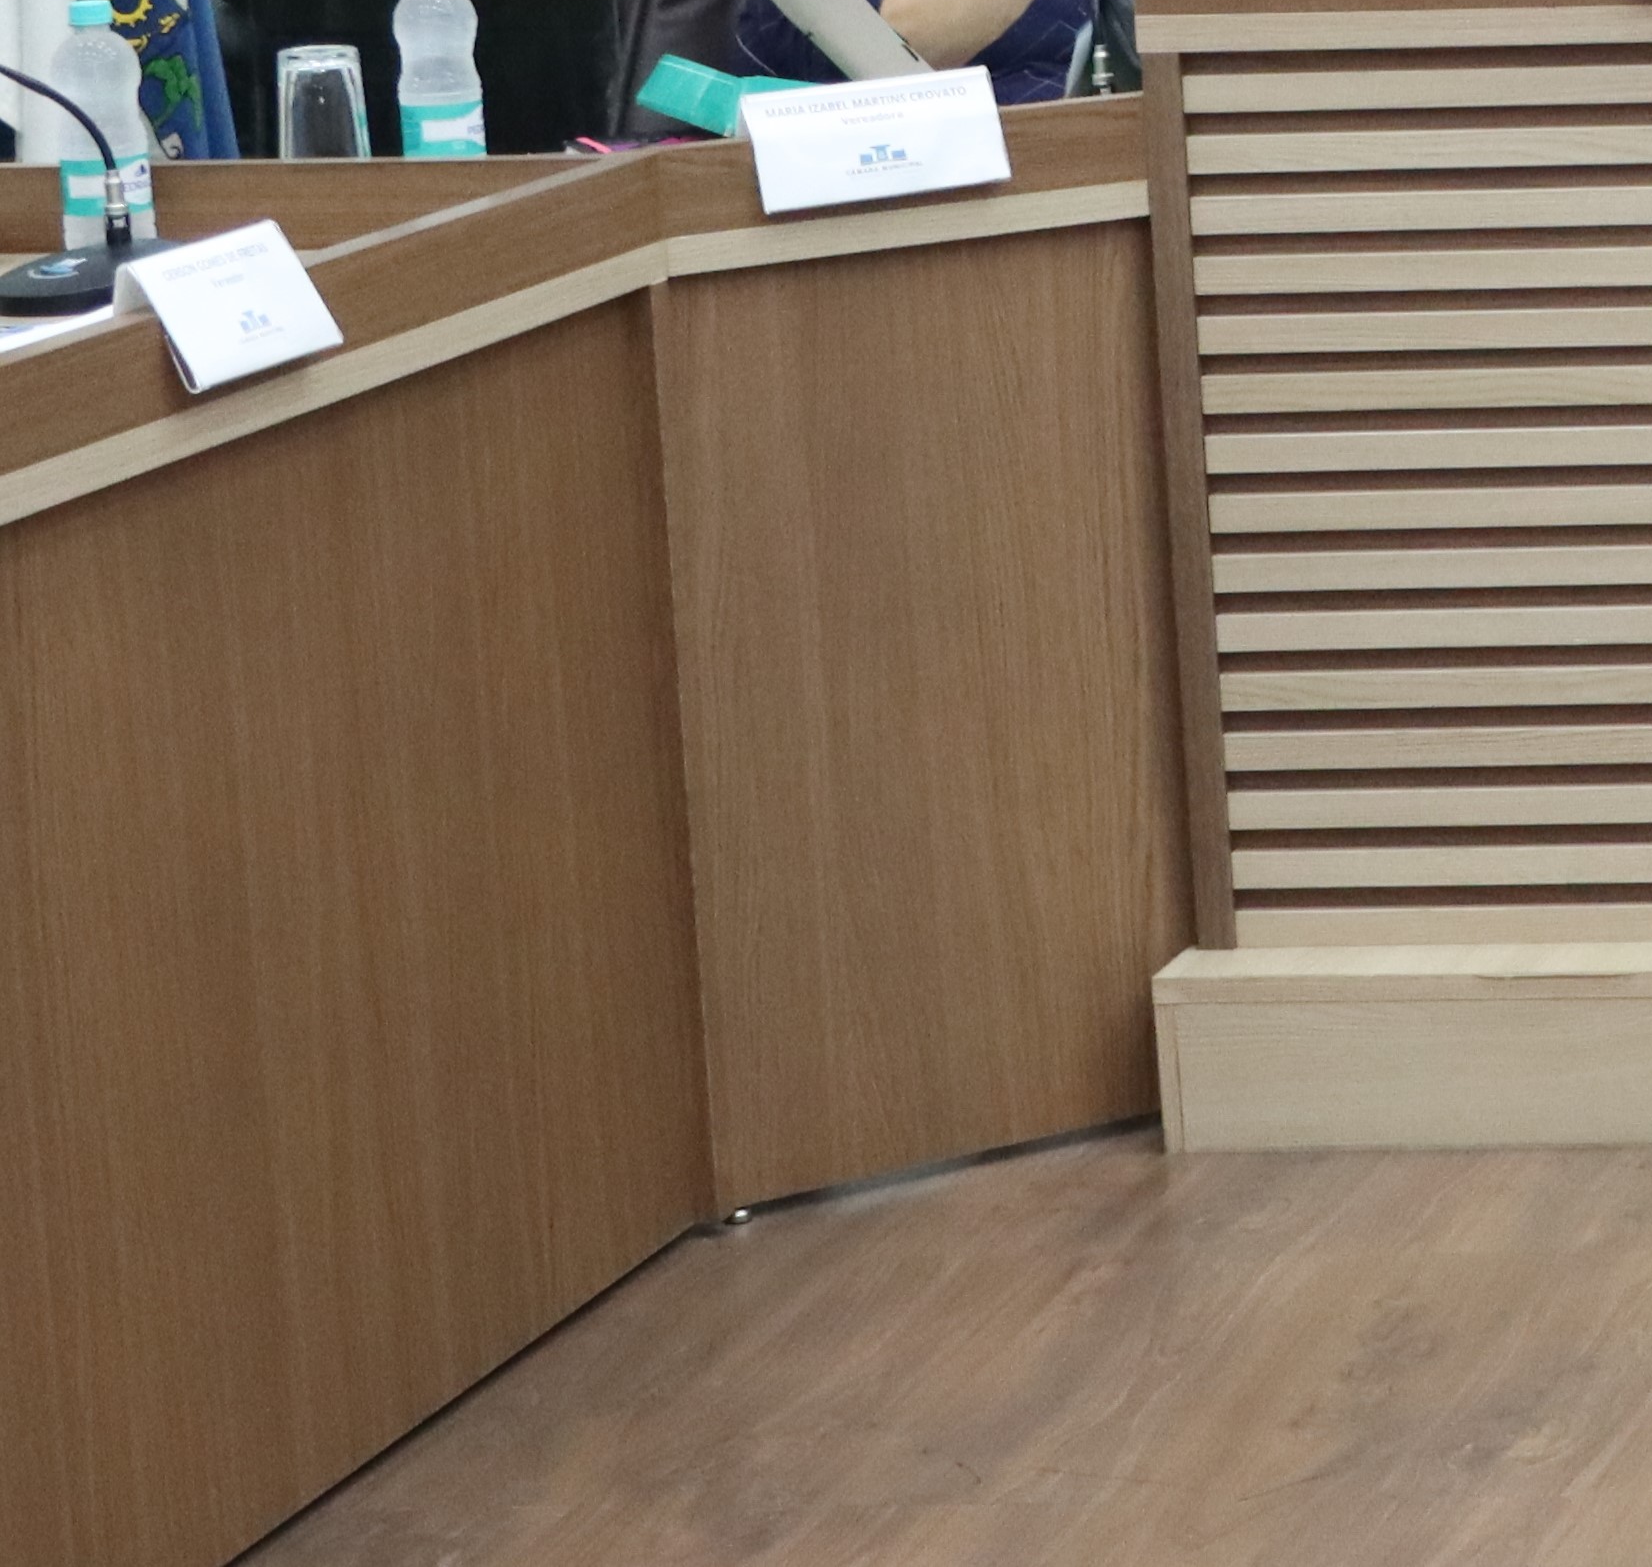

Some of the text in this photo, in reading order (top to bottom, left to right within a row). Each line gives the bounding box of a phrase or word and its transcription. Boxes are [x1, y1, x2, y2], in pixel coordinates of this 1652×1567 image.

[765, 85, 967, 118] MARIA IZABEL MARTINS CROVATO
[841, 111, 905, 126] Vereadora
